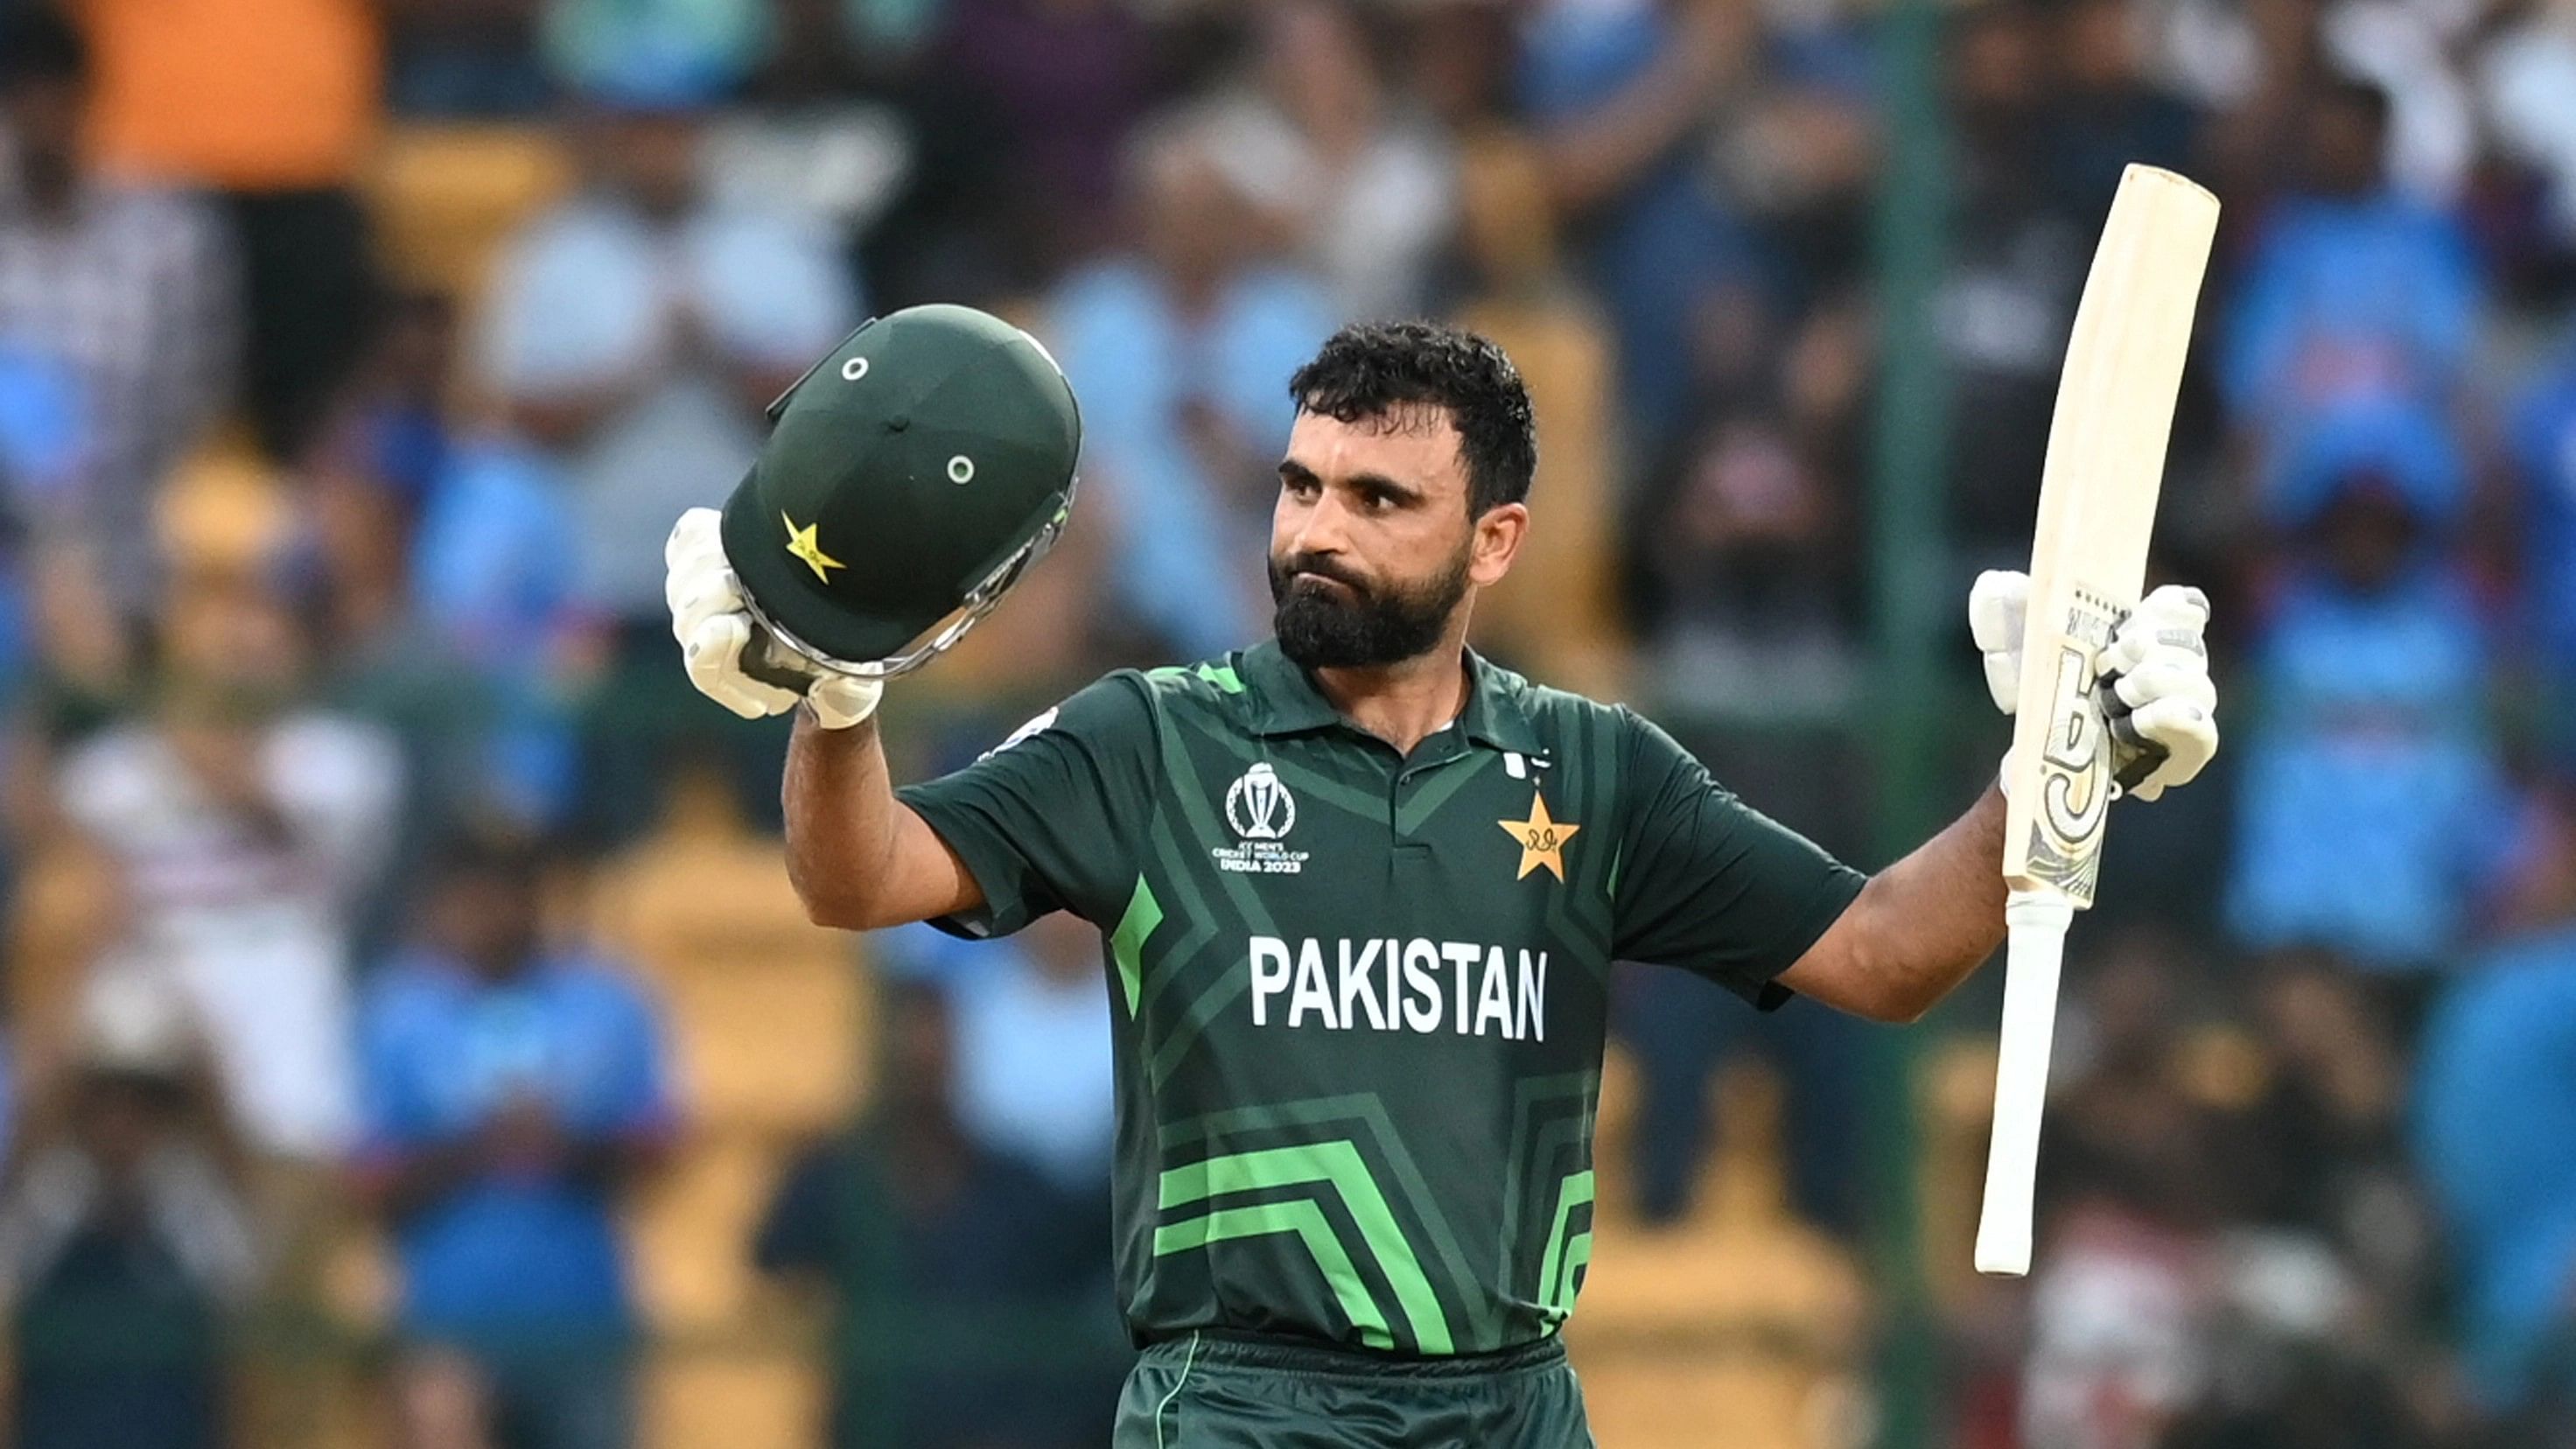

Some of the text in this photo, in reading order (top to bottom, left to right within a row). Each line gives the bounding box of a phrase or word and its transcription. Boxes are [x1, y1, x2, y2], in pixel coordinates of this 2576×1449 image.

[1221, 858, 1301, 873] INDIA 2023
[1250, 935, 1548, 1042] PAKISTAN
